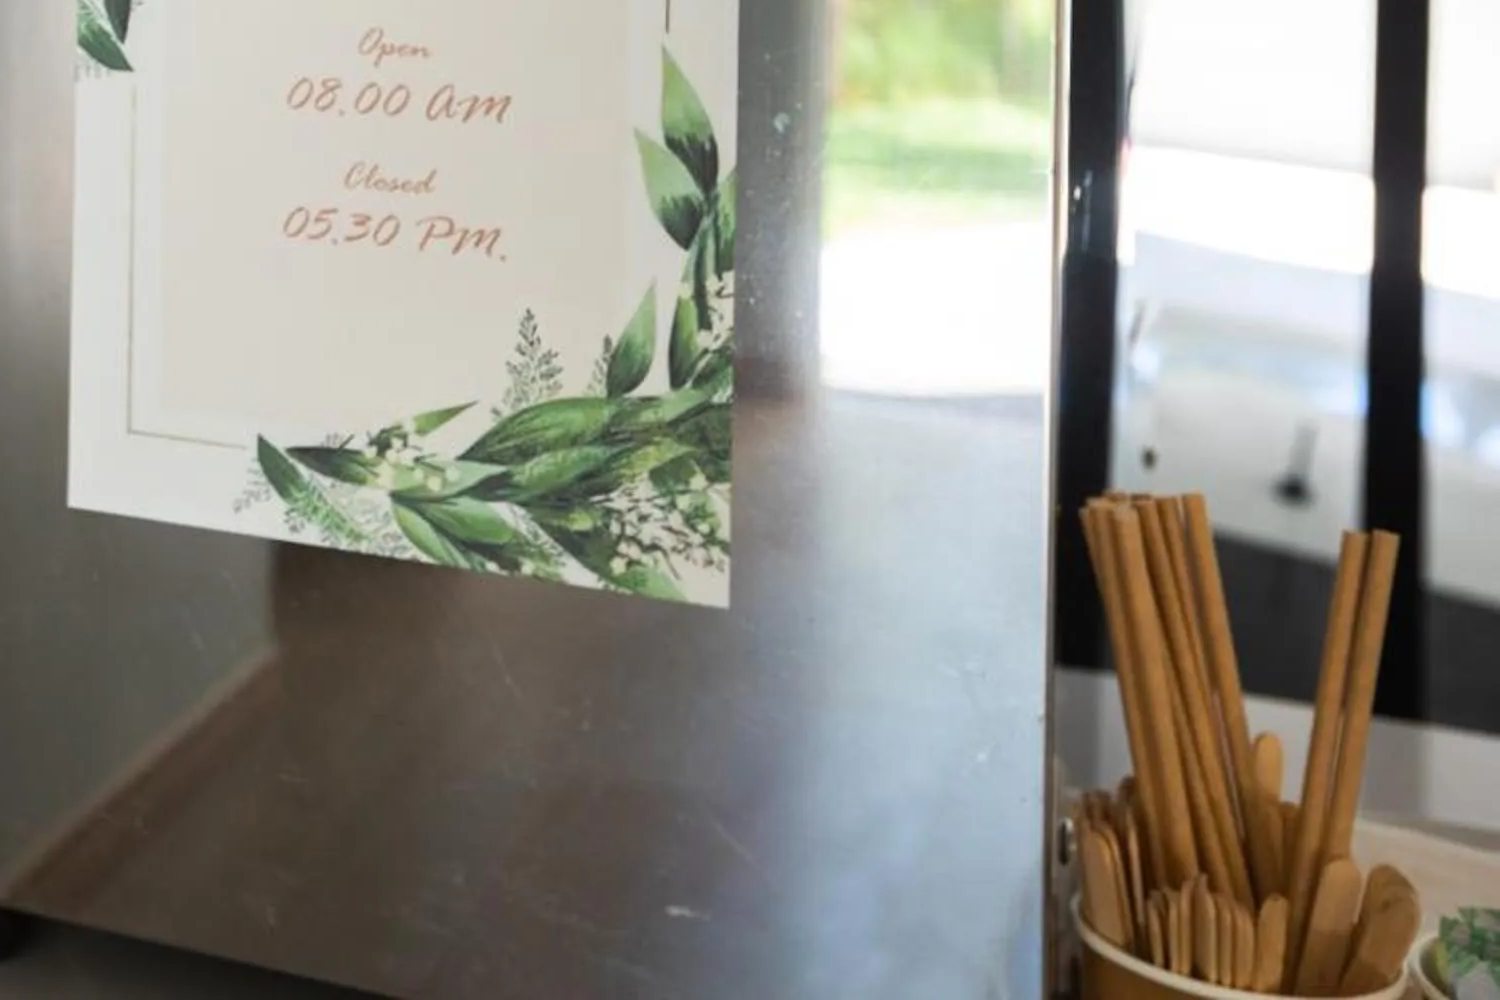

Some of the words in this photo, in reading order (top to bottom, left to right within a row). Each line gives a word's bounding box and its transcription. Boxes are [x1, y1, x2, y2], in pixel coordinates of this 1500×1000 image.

[357, 26, 431, 67] Open
[286, 76, 411, 118] 08.00
[344, 161, 437, 194] Closed
[283, 206, 401, 247] 05.30
